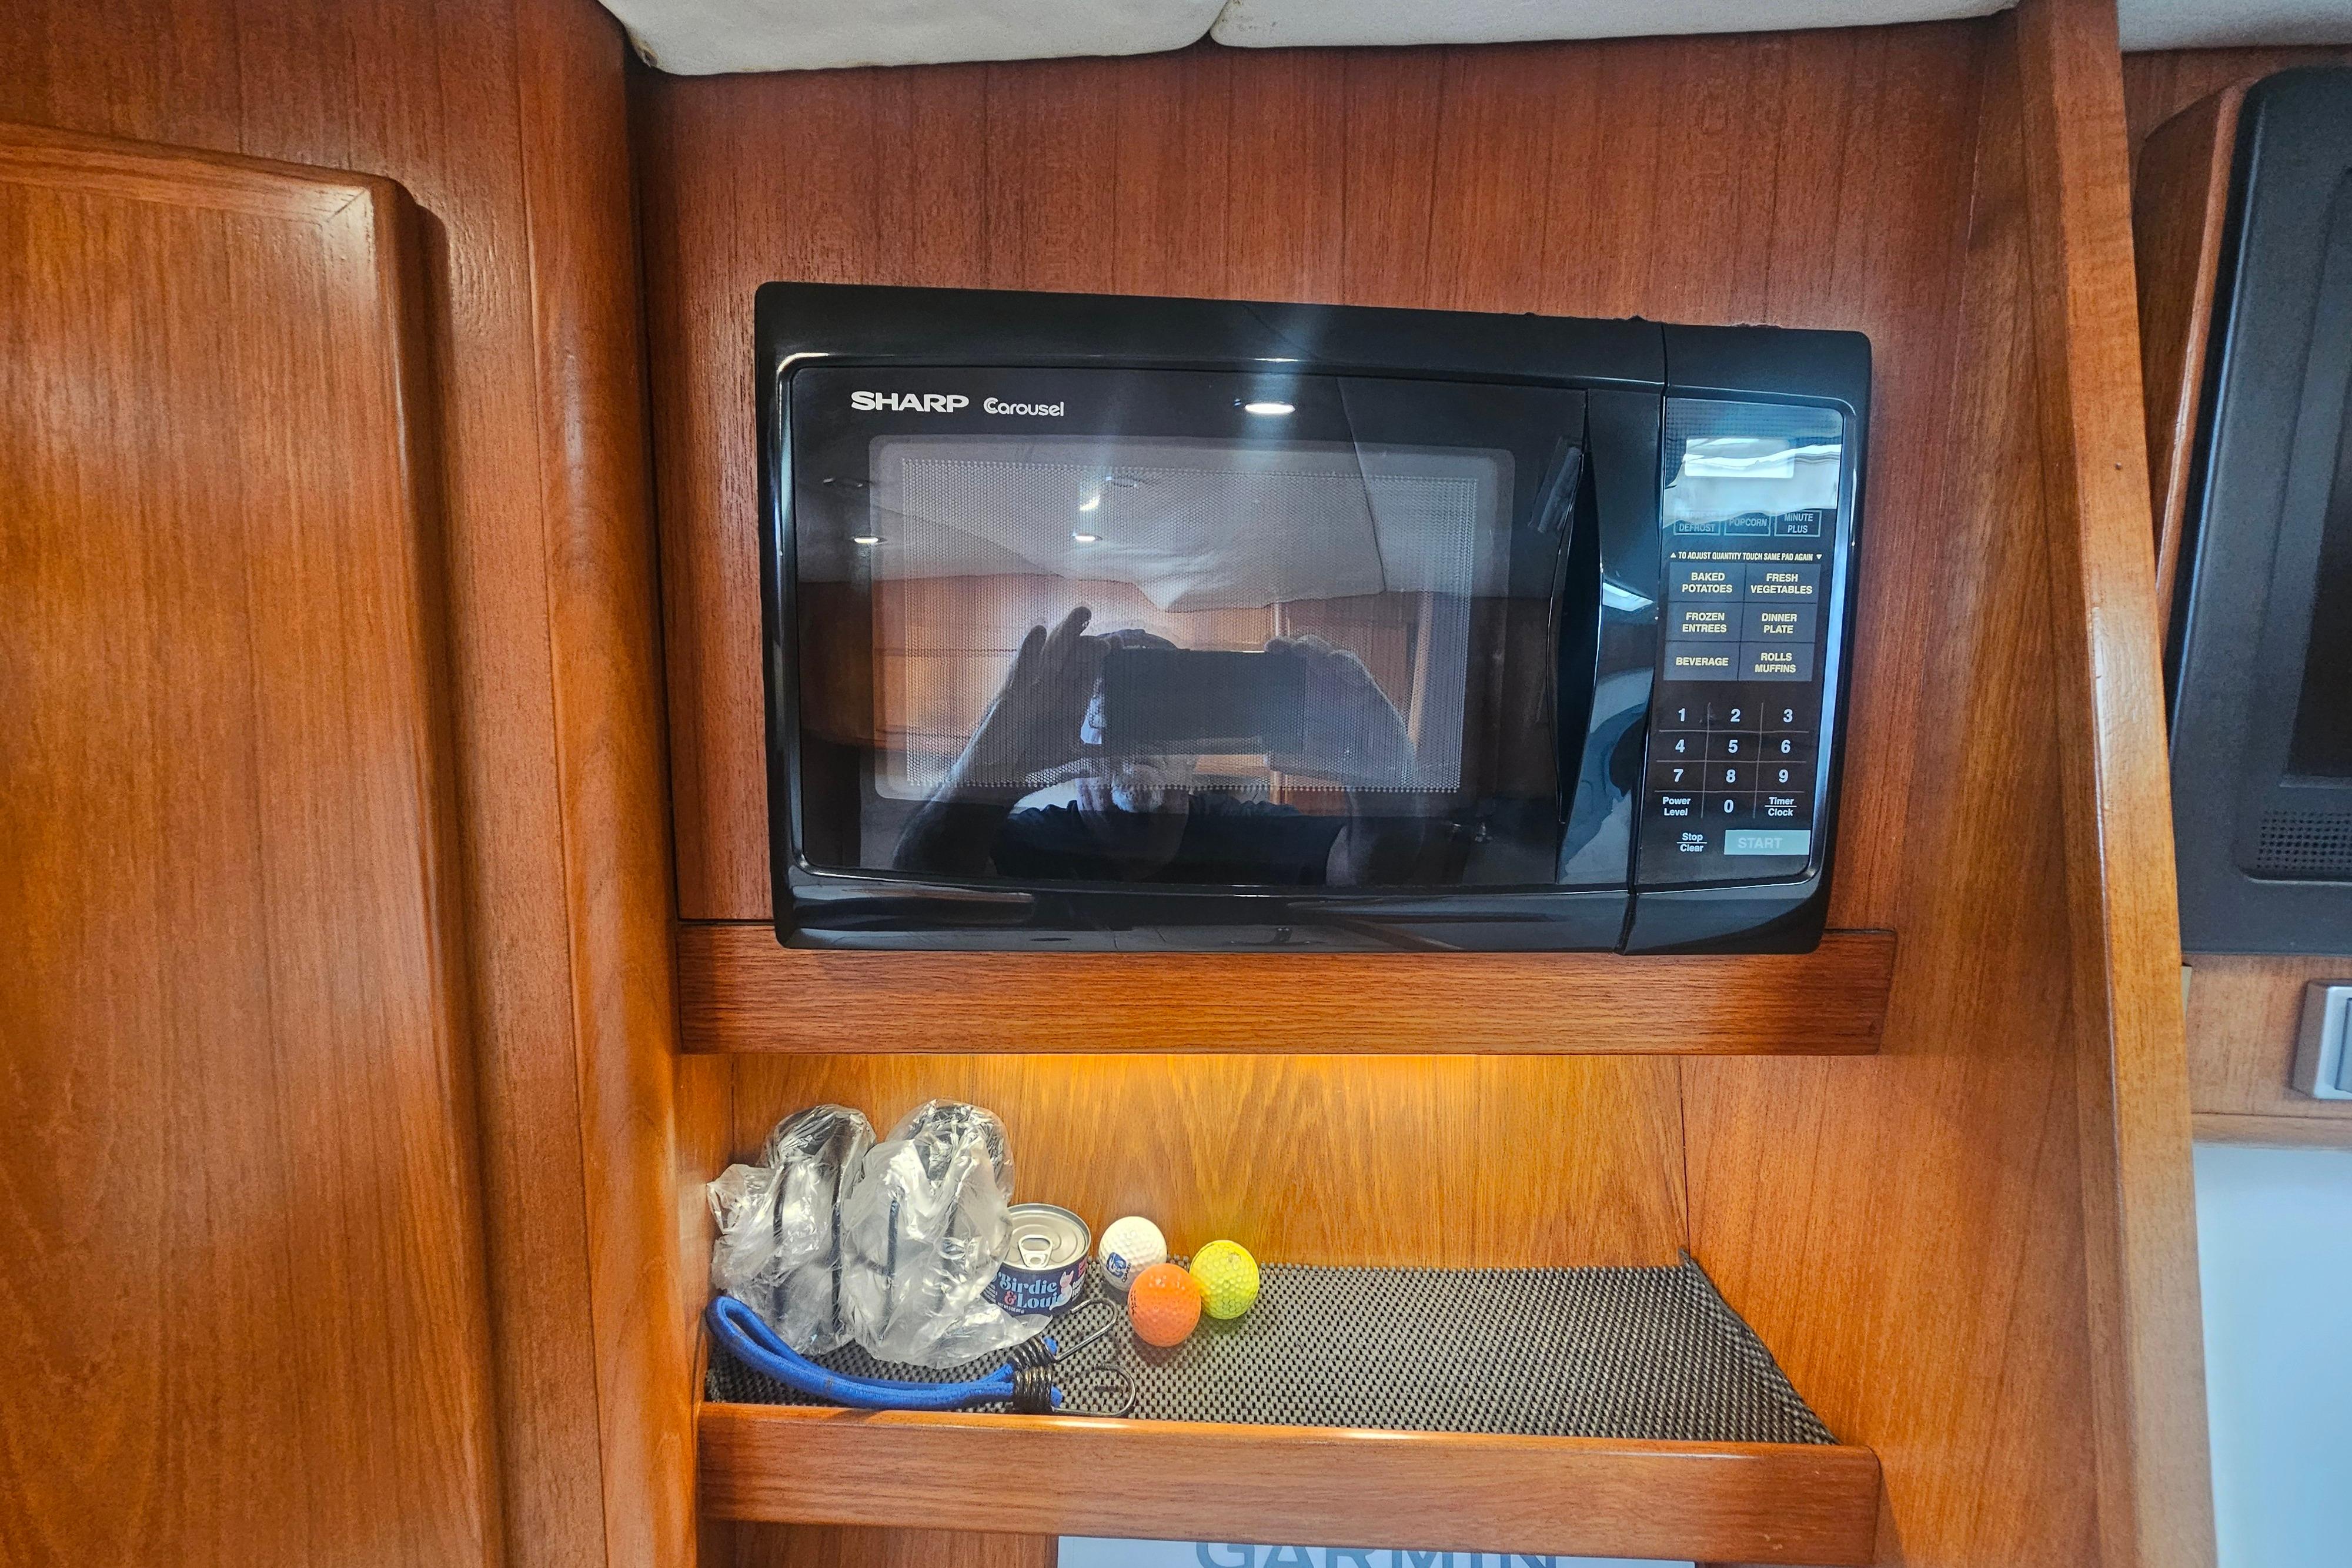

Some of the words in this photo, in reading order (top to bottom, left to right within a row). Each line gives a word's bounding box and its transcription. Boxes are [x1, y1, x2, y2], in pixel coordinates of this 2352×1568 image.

[851, 391, 969, 413] SHARP
[983, 397, 1064, 416] Carousel
[1784, 513, 1813, 521] MINUTE
[1729, 518, 1767, 527] POPCORN
[1679, 523, 1715, 532] DEFROST
[1788, 525, 1808, 534] PLUS
[1688, 551, 1711, 560] ADJUST
[1712, 552, 1742, 560] QUANTITY
[1691, 573, 1725, 581] BAKED
[1766, 573, 1798, 582] FRESH
[1682, 584, 1733, 593] POTATOES
[1750, 585, 1813, 594] VEGETABLES
[1686, 612, 1725, 621] FROZEN
[1762, 613, 1798, 622] DINNER
[1682, 624, 1727, 633] ENTREES
[1763, 624, 1793, 633] PLATE
[1676, 657, 1729, 666] BEVERAGE
[1760, 653, 1792, 661] ROLLS
[1755, 664, 1796, 673] MUFFINS
[1678, 708, 1686, 722] 1
[1730, 708, 1741, 722] 2
[1783, 708, 1793, 723] 3
[1675, 739, 1685, 753] 4
[1728, 740, 1738, 753] 5
[1780, 739, 1791, 754] 6
[1673, 768, 1684, 782] 7
[1725, 769, 1736, 783] 8
[1778, 769, 1789, 783] 9
[1662, 796, 1691, 805] Power
[1769, 797, 1795, 805] Timer
[1723, 799, 1734, 813] 0
[1768, 808, 1793, 817] Clock
[1682, 833, 1703, 843] Stop
[1737, 837, 1783, 849] START
[1680, 844, 1704, 852] Clear
[998, 1271, 1057, 1294] Birdie
[1004, 1290, 1017, 1305] &
